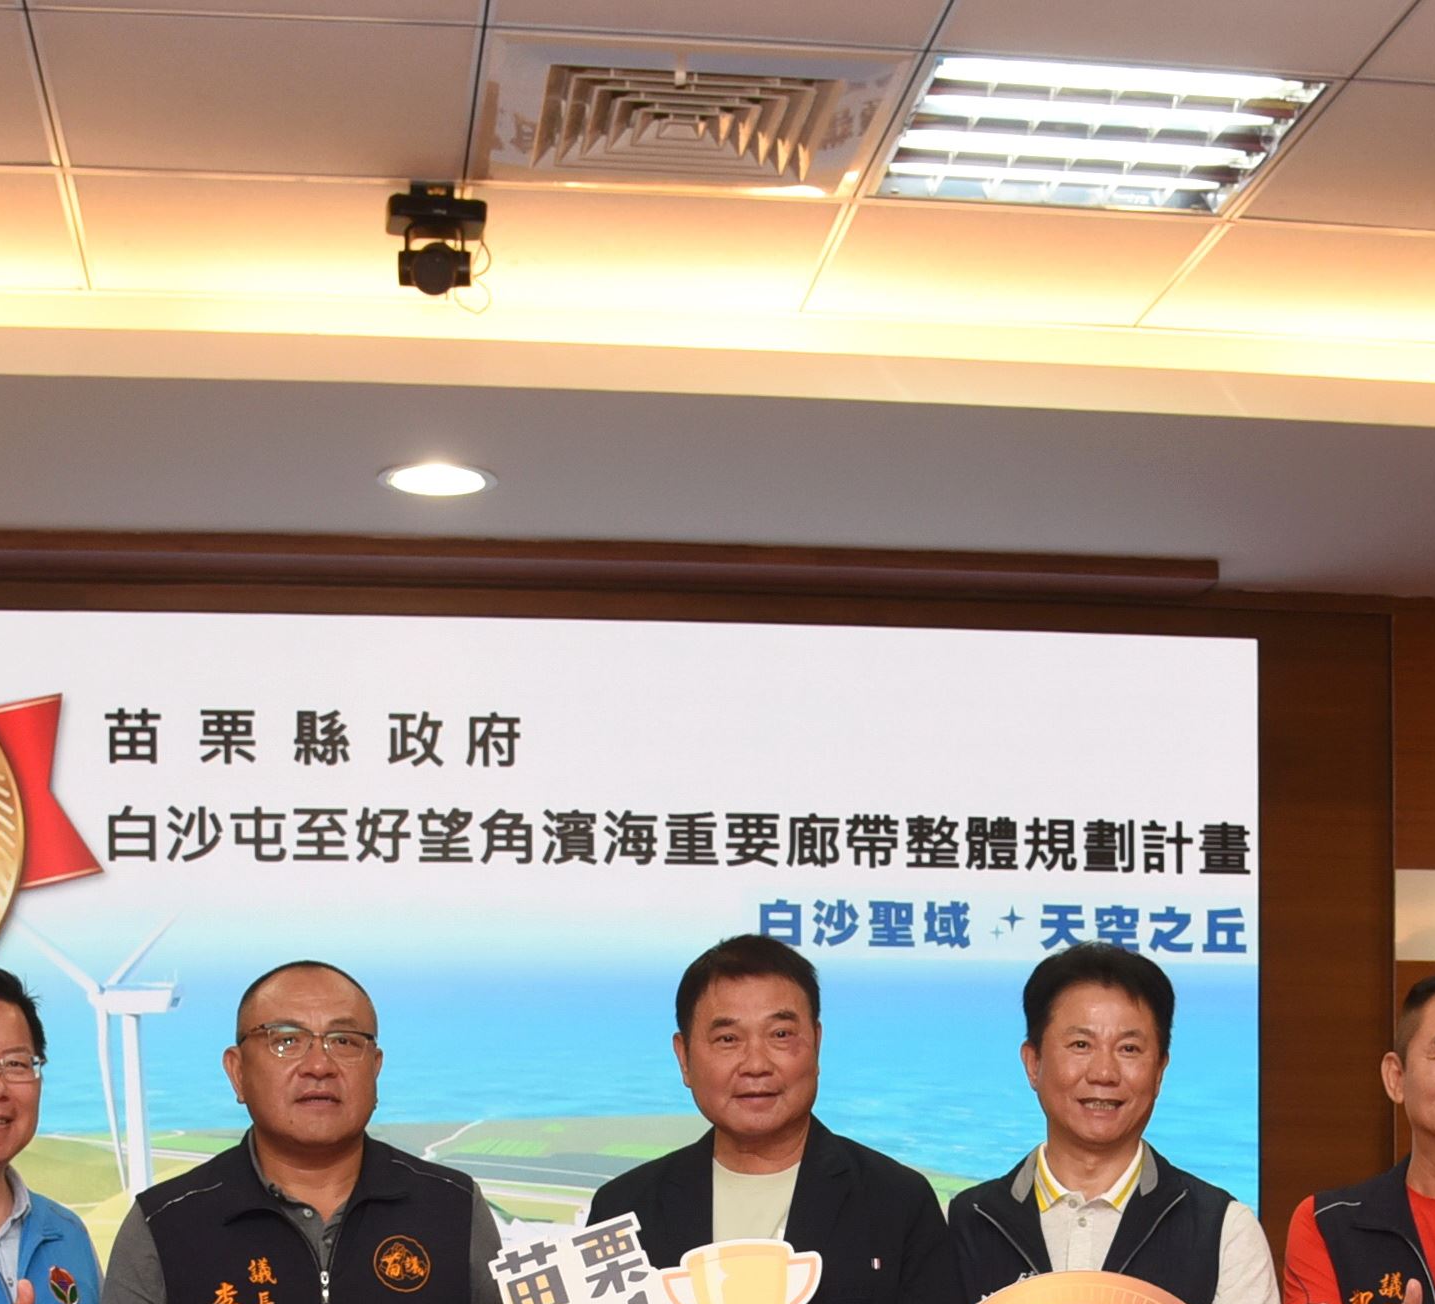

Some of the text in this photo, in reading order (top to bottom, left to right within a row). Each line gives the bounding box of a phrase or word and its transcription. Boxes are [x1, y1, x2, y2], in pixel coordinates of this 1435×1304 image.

[104, 707, 522, 768] 苗栗縣政府
[107, 804, 1253, 876] 白沙屯至好望角濱海重要廊帶整體規劃計畫
[759, 898, 1249, 954] 白沙聖域 天空之丘
